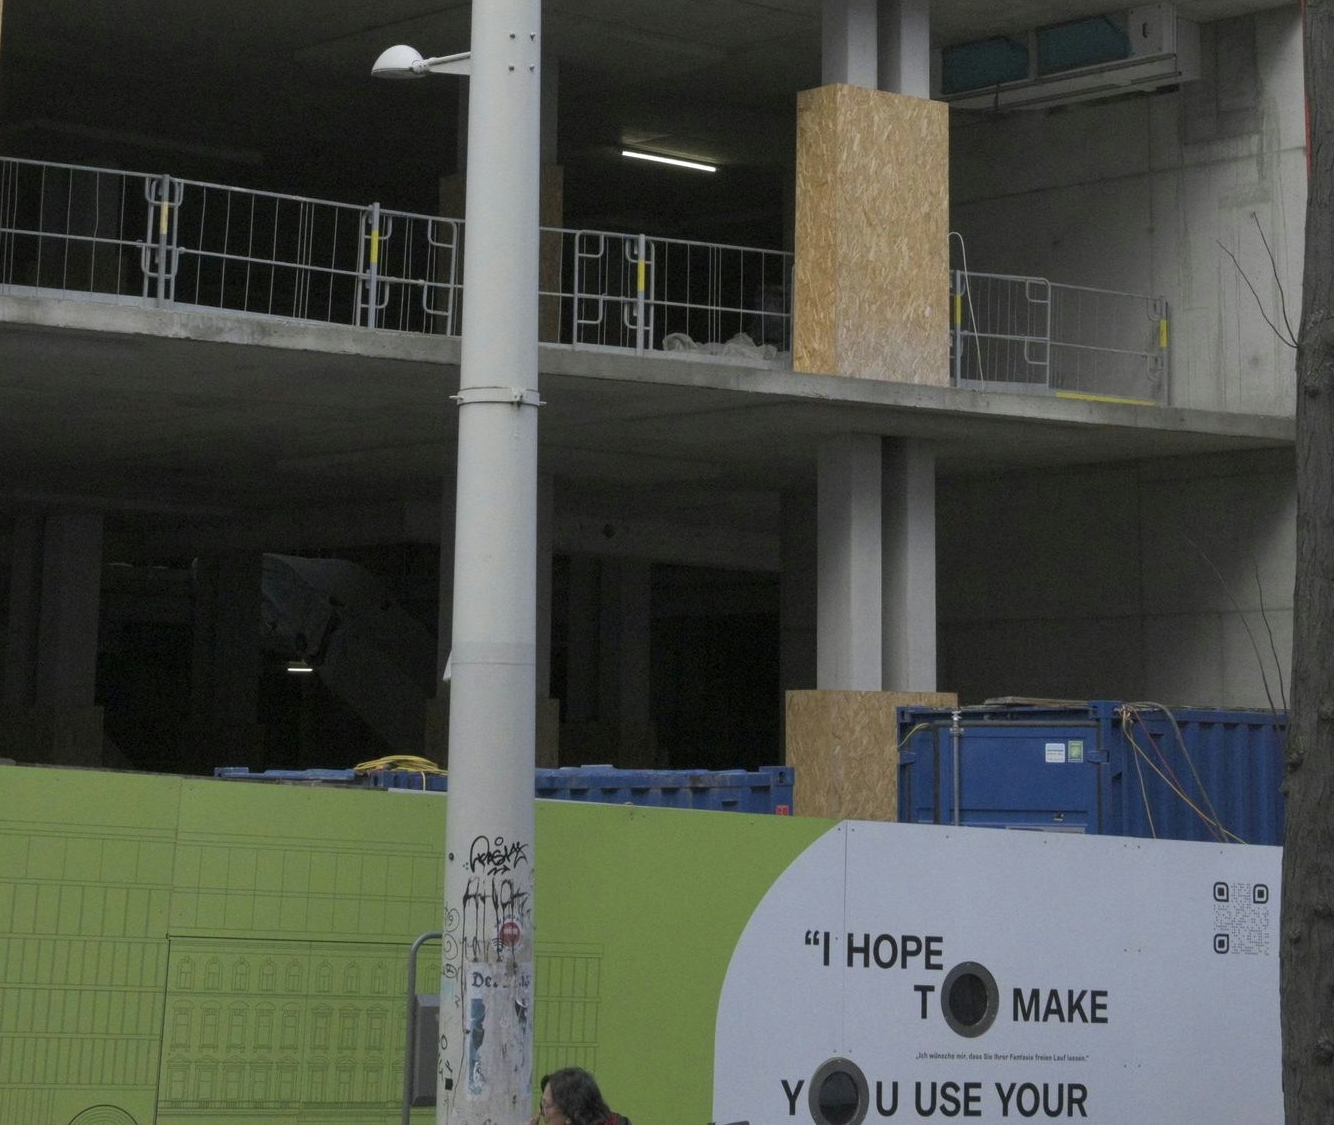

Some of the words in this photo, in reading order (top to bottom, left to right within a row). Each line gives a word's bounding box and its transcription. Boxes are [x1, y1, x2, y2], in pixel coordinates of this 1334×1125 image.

[847, 933, 943, 970] HOPE
[1013, 988, 1108, 1024] MAKE
[915, 1081, 982, 1117] USE
[995, 1082, 1088, 1118] YOUR
